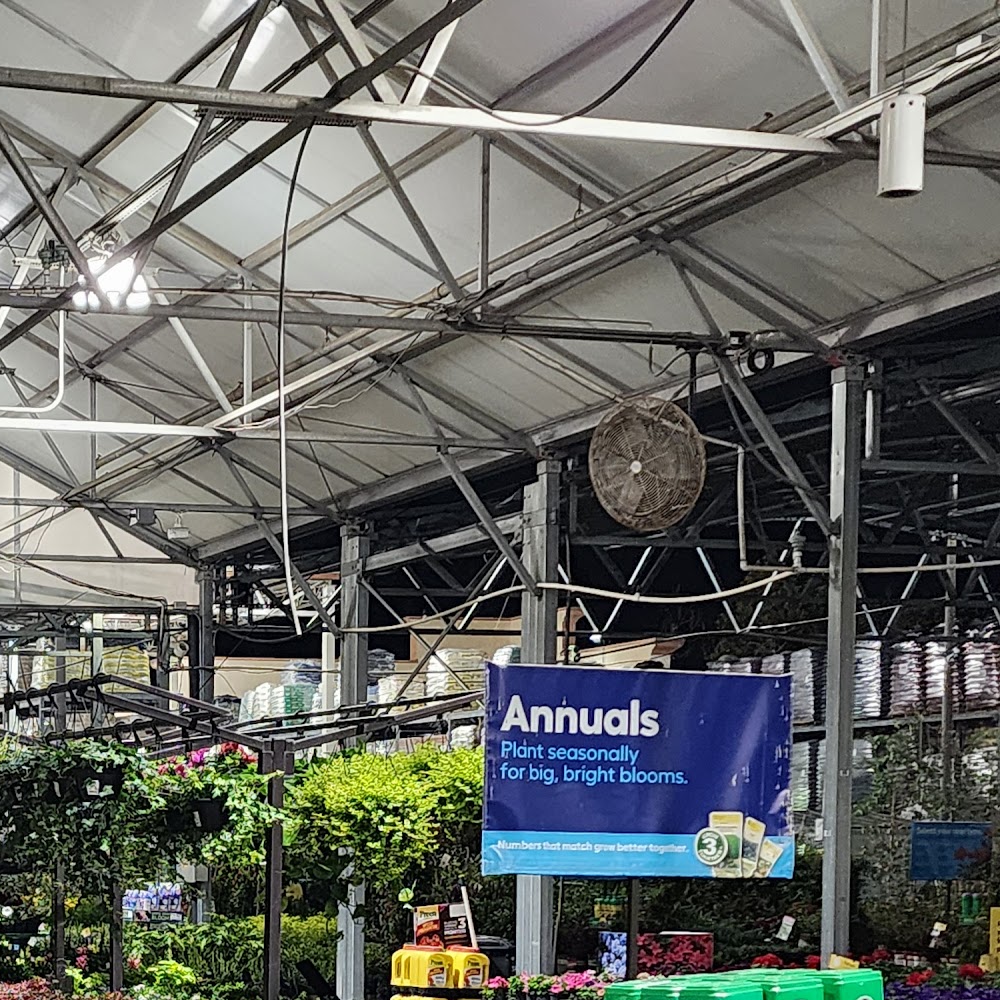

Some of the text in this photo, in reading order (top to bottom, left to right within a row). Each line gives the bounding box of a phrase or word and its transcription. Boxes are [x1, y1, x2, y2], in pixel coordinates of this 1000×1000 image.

[500, 694, 660, 737] Annuals
[501, 740, 639, 766] Plant seasonally
[500, 762, 689, 786] for big, bright blooms.
[497, 840, 542, 850] Numbers
[543, 840, 561, 850] that
[562, 841, 592, 851] match
[594, 843, 617, 853] grow
[617, 843, 647, 853] better
[701, 837, 718, 856] 3
[457, 917, 467, 929] 3
